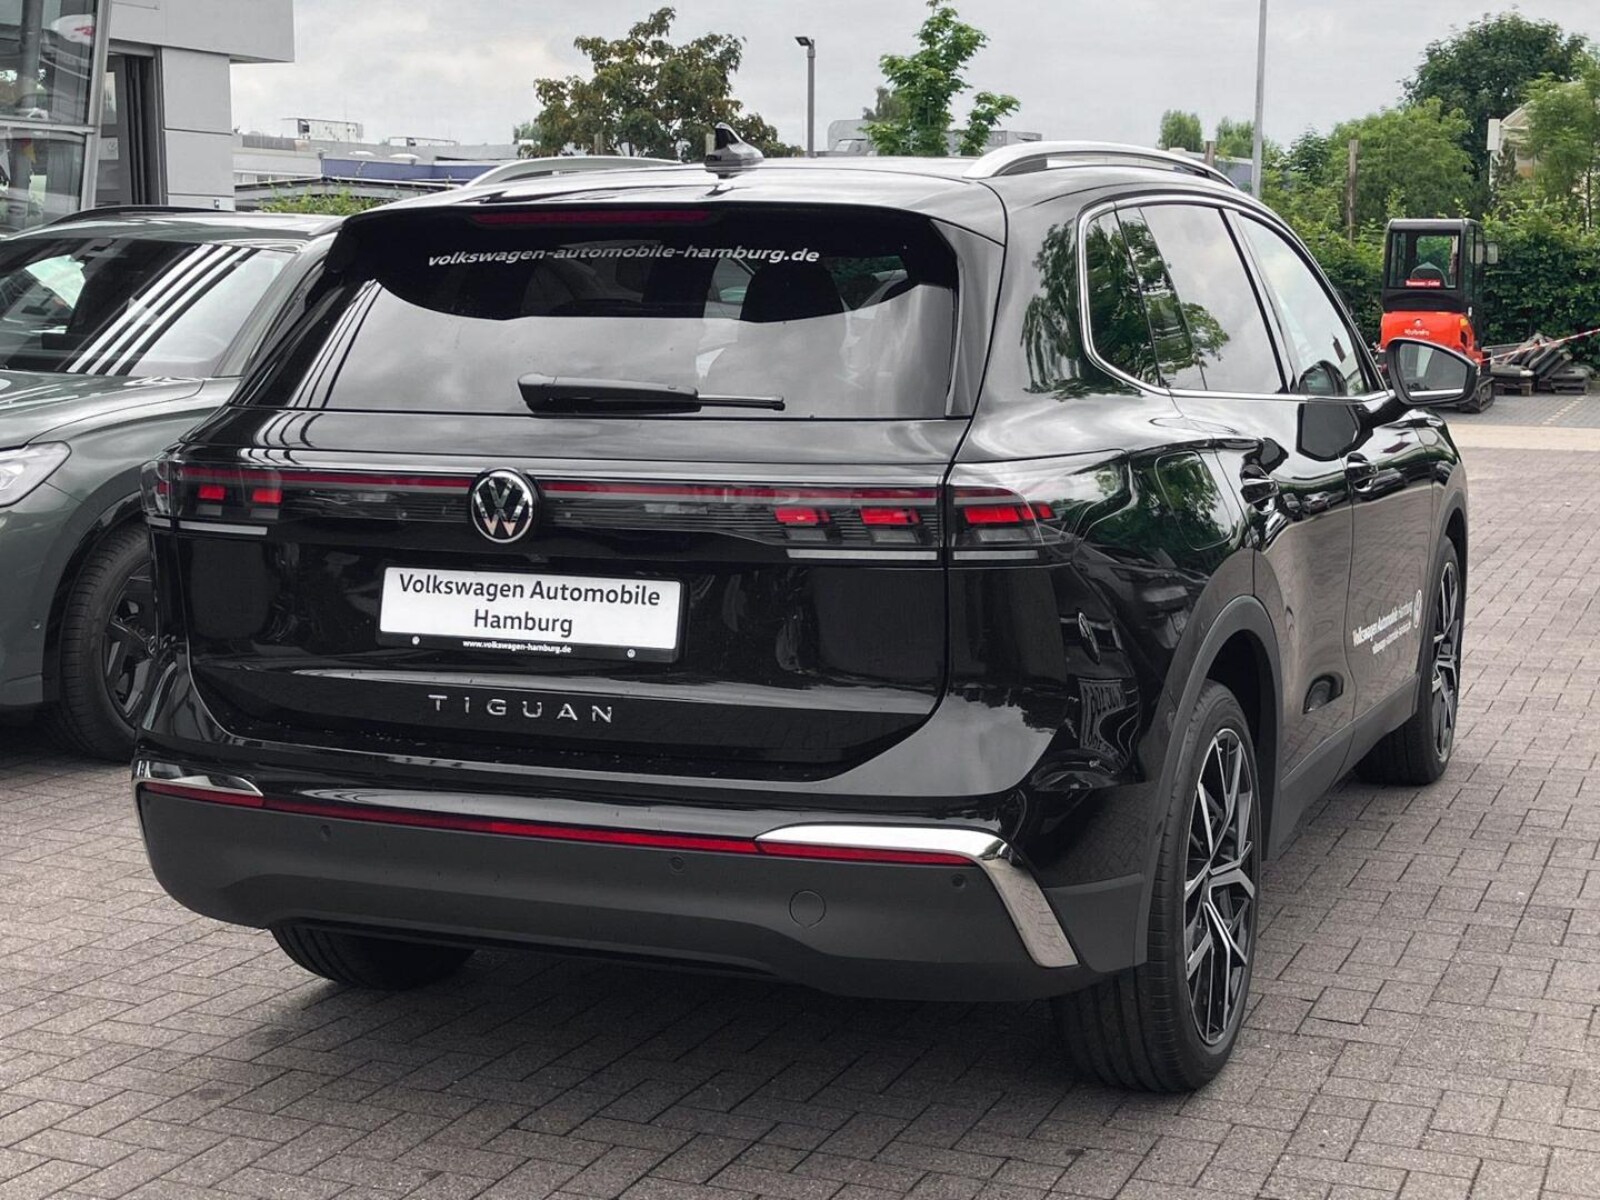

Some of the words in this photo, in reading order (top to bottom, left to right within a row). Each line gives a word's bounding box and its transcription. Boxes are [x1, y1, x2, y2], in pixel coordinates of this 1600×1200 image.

[428, 245, 820, 267] volkswagen-automobile-hamburg.de
[399, 574, 524, 601] Volkswagen
[530, 581, 660, 606] Automobile
[473, 609, 573, 637] Hamburg
[462, 641, 572, 654] www.volkswagen-hamburg.de
[428, 694, 612, 723] TIGUAN
